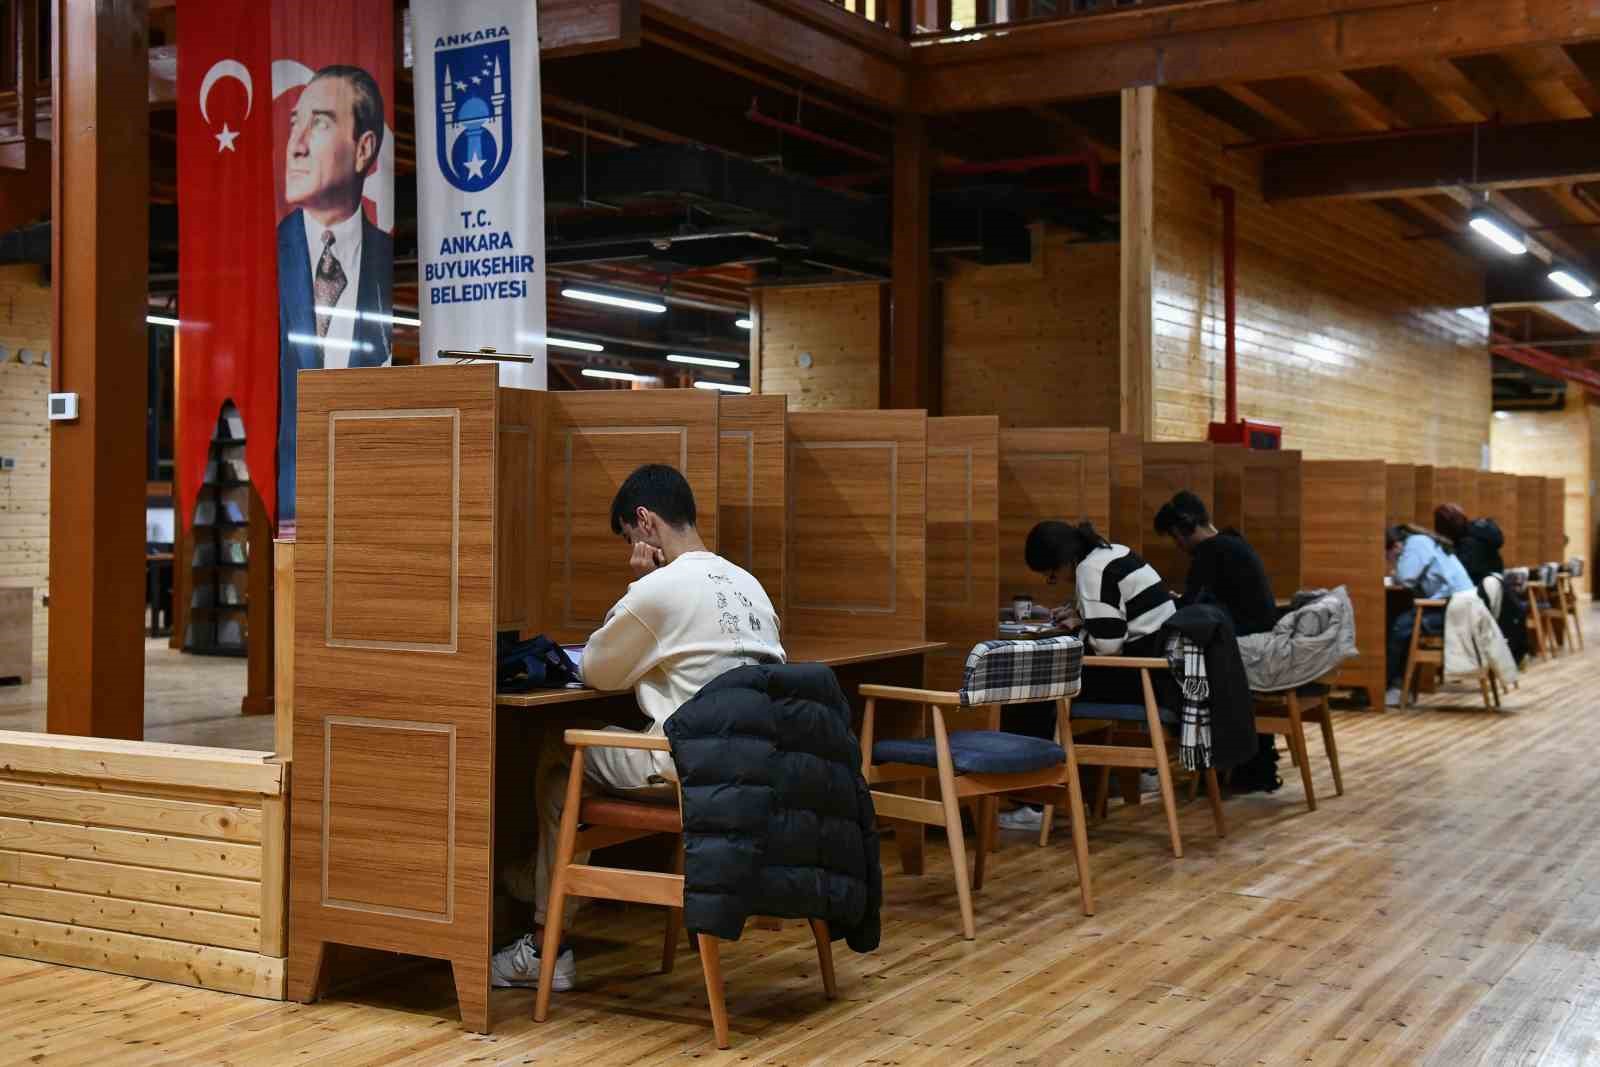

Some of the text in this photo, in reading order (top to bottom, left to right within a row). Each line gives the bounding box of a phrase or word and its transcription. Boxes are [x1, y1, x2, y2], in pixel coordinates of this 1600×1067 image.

[434, 25, 510, 48] ANKARA
[460, 209, 491, 229] T.C.
[440, 231, 513, 255] ANKARA
